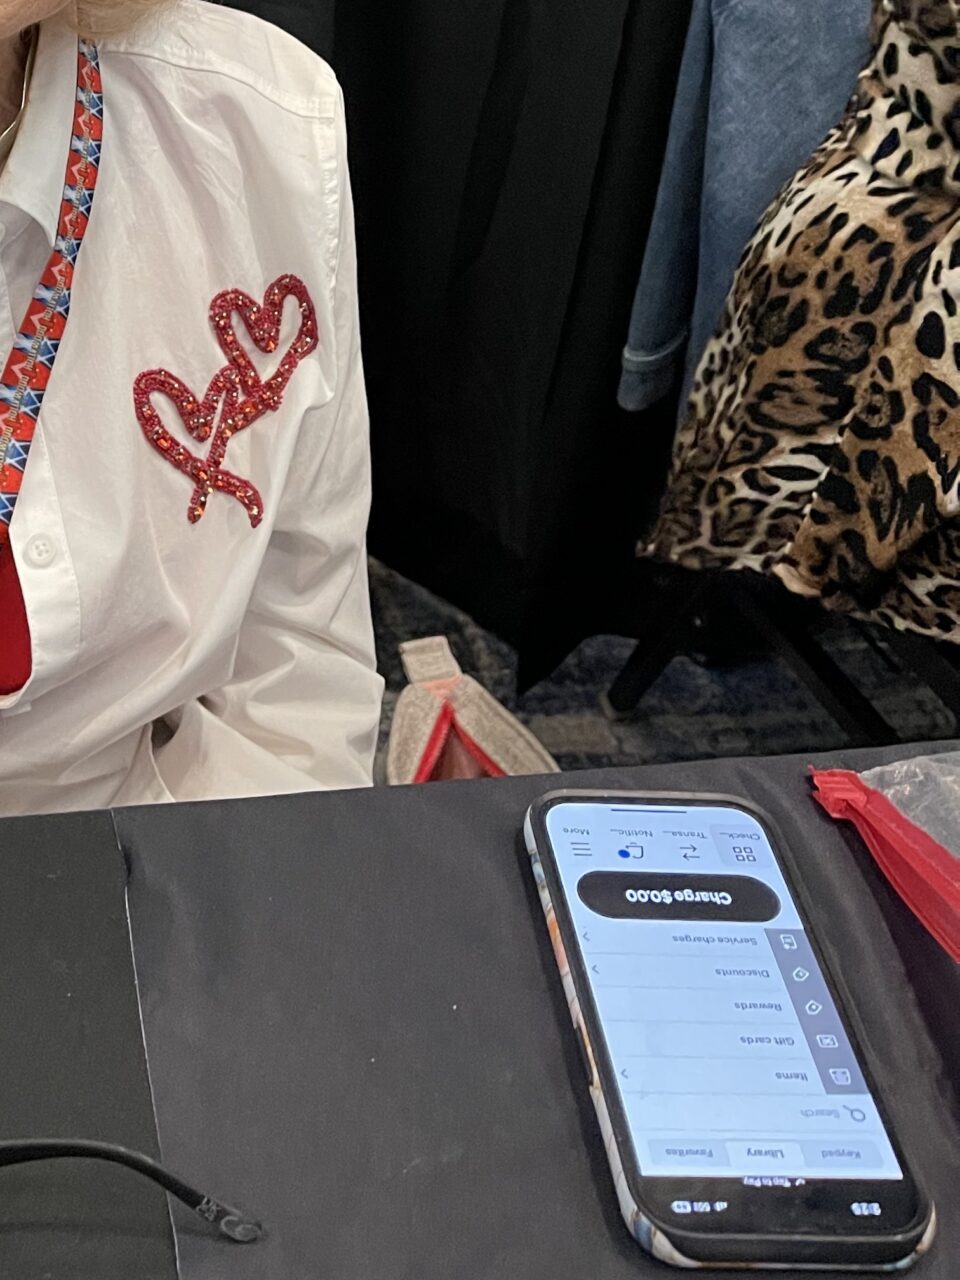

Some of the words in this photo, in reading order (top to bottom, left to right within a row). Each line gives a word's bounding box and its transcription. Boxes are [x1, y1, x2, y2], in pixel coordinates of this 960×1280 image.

[562, 826, 590, 836] More
[625, 888, 673, 905] $0.00
[674, 888, 733, 906] Charge
[672, 934, 716, 945] charges
[717, 936, 758, 946] Service
[714, 968, 771, 979] Discounts
[734, 1001, 783, 1012] Rewards
[739, 1035, 770, 1047] cards
[771, 1035, 796, 1047] Gift
[775, 1071, 808, 1082] Items
[800, 1108, 841, 1119] Search
[665, 1147, 715, 1158] Favorites
[746, 1147, 785, 1159] Library
[820, 1148, 862, 1160] Keypad
